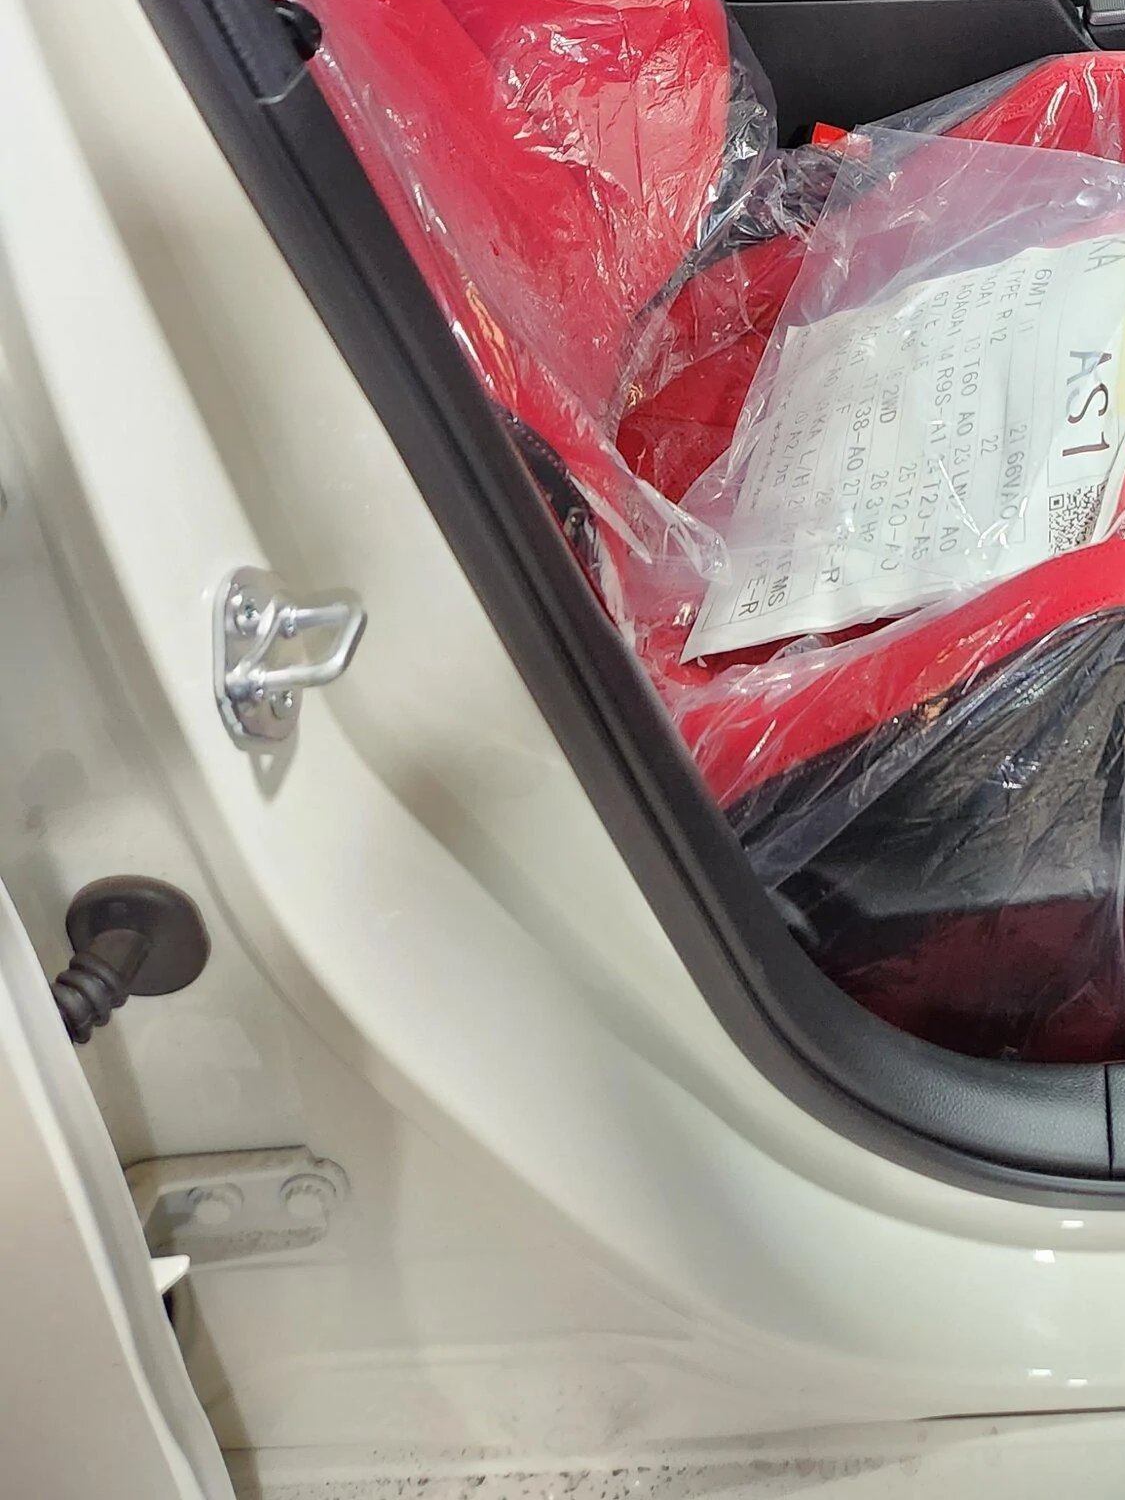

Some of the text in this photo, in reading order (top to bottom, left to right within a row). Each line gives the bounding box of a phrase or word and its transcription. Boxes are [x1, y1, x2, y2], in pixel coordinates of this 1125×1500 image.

[960, 358, 980, 397] T60
[979, 268, 1025, 457] TYPE R 12 22
[879, 386, 899, 424] 2WD
[929, 366, 955, 444] R9S-A1
[1062, 352, 1112, 457] AS1
[846, 396, 874, 472] T38-A0
[842, 478, 861, 497] 27
[869, 470, 889, 490] 26
[898, 462, 917, 483] 25
